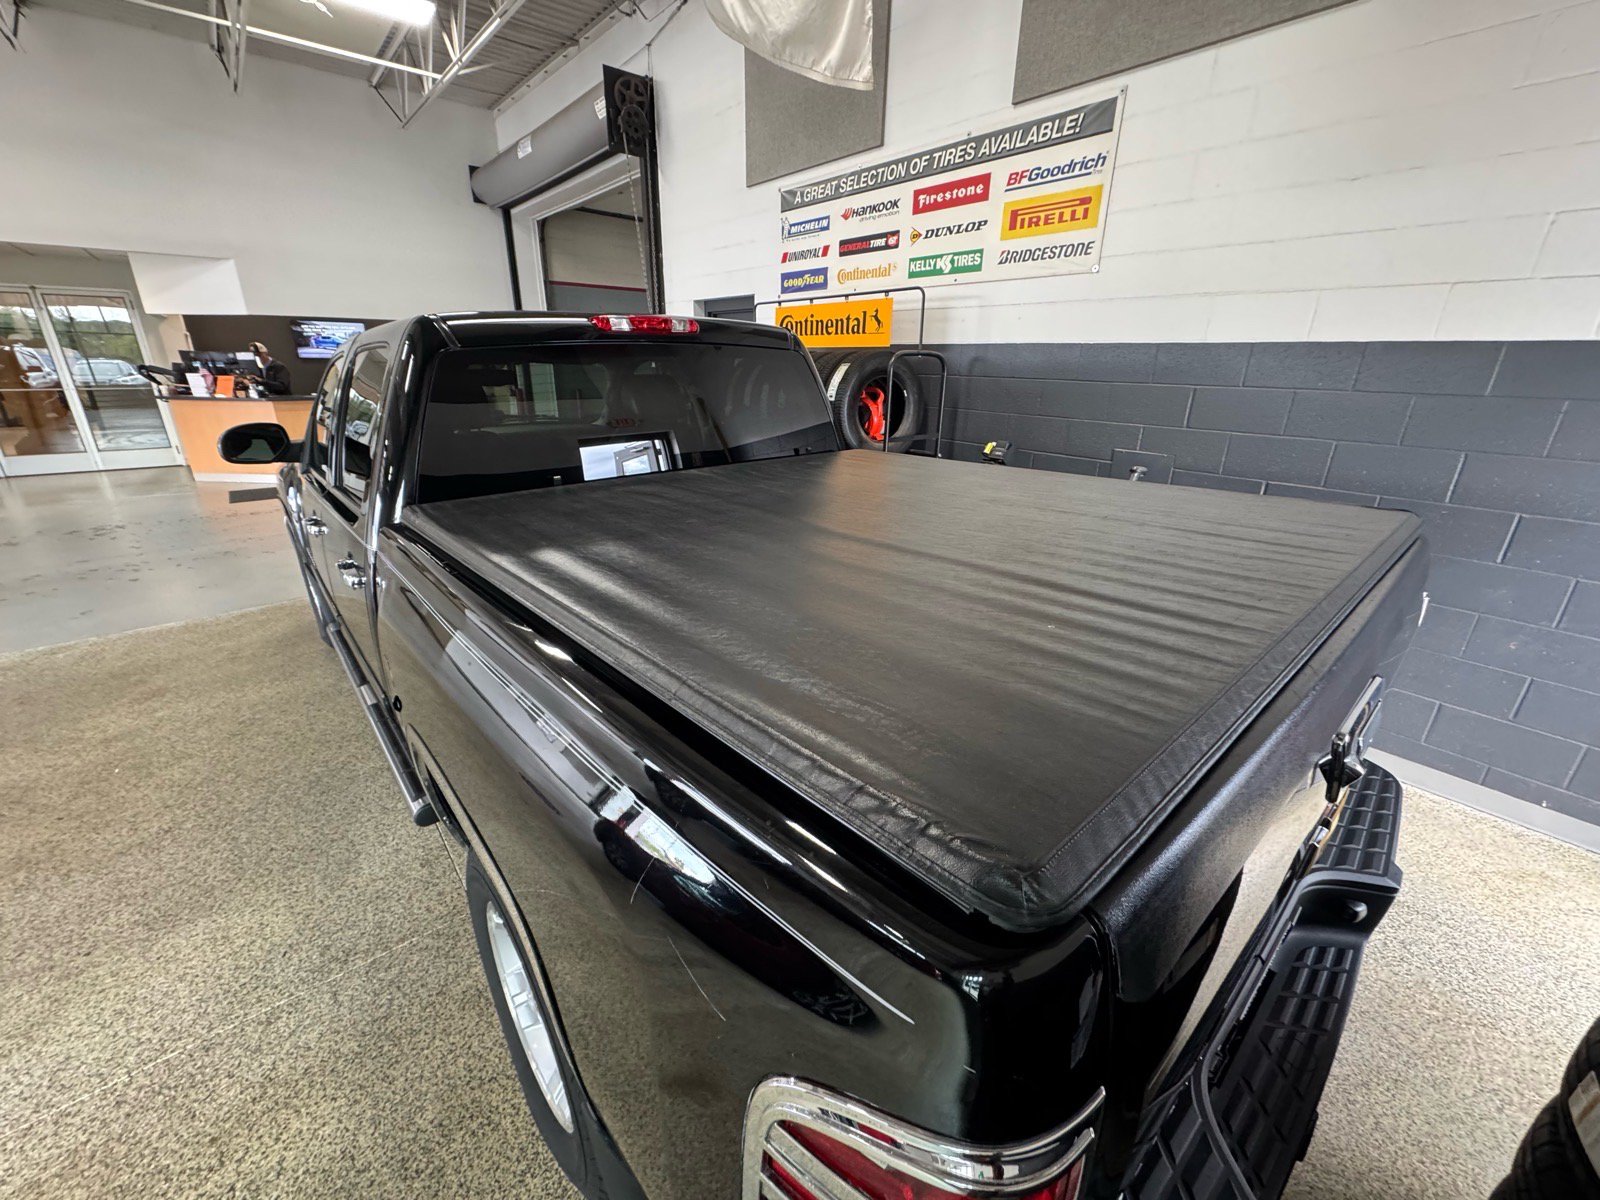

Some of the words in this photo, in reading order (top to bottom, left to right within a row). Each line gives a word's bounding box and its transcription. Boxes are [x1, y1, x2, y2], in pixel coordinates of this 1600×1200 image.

[793, 191, 802, 204] A
[803, 180, 838, 201] GREAT
[839, 161, 907, 193] SELECTION
[910, 155, 930, 174] OF
[932, 142, 976, 169] TIRES
[978, 112, 1085, 157] AVAILABLE!
[1006, 152, 1107, 187] BFGoodrich
[918, 182, 985, 209] Firestone
[1008, 196, 1093, 231] PIRELLI
[790, 218, 829, 234] MICHELIN
[923, 219, 988, 239] DUNLOP
[788, 247, 821, 263] UNIROYAL
[909, 257, 936, 273] KELLY
[953, 252, 981, 268] TIRES
[998, 241, 1095, 265] BRIDGESTONE
[783, 274, 825, 288] GOODYEAR
[837, 263, 892, 285] Continental
